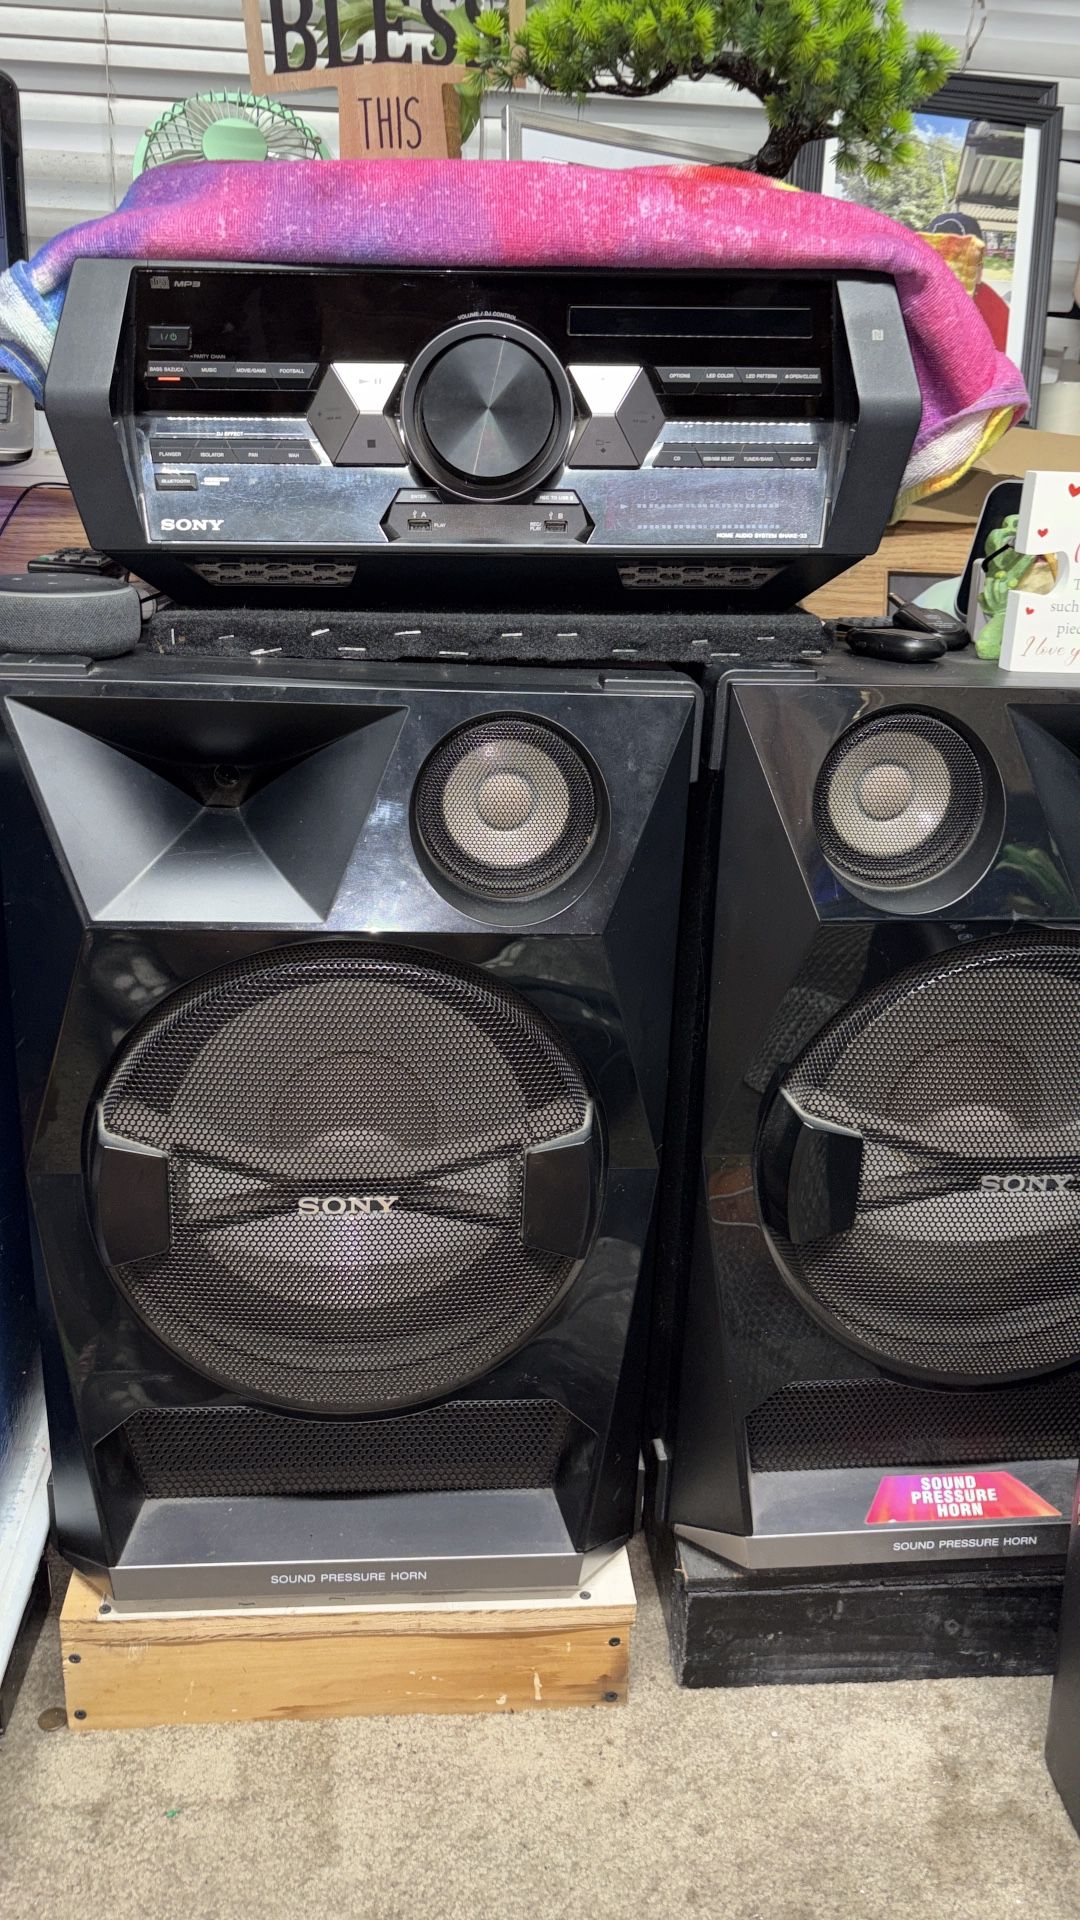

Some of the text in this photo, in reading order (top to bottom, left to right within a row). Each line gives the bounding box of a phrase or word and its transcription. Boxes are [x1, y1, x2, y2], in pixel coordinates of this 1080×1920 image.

[358, 96, 422, 149] THIS
[174, 280, 201, 288] MP3
[457, 311, 479, 320] VOLUME
[492, 311, 517, 320] CONTROL
[160, 519, 225, 531] SONY
[1050, 600, 1079, 612] such
[1021, 636, 1036, 657] I
[1036, 637, 1065, 657] love
[980, 1174, 1075, 1192] SONY
[298, 1196, 399, 1215] SONY
[920, 1475, 976, 1491] SOUND
[911, 1488, 997, 1504] PRESSURE
[937, 1503, 983, 1517] HORN
[893, 1536, 1038, 1551] SOUND PRESSURE HORN
[270, 1571, 427, 1584] SOUND PRESSURE HORN
